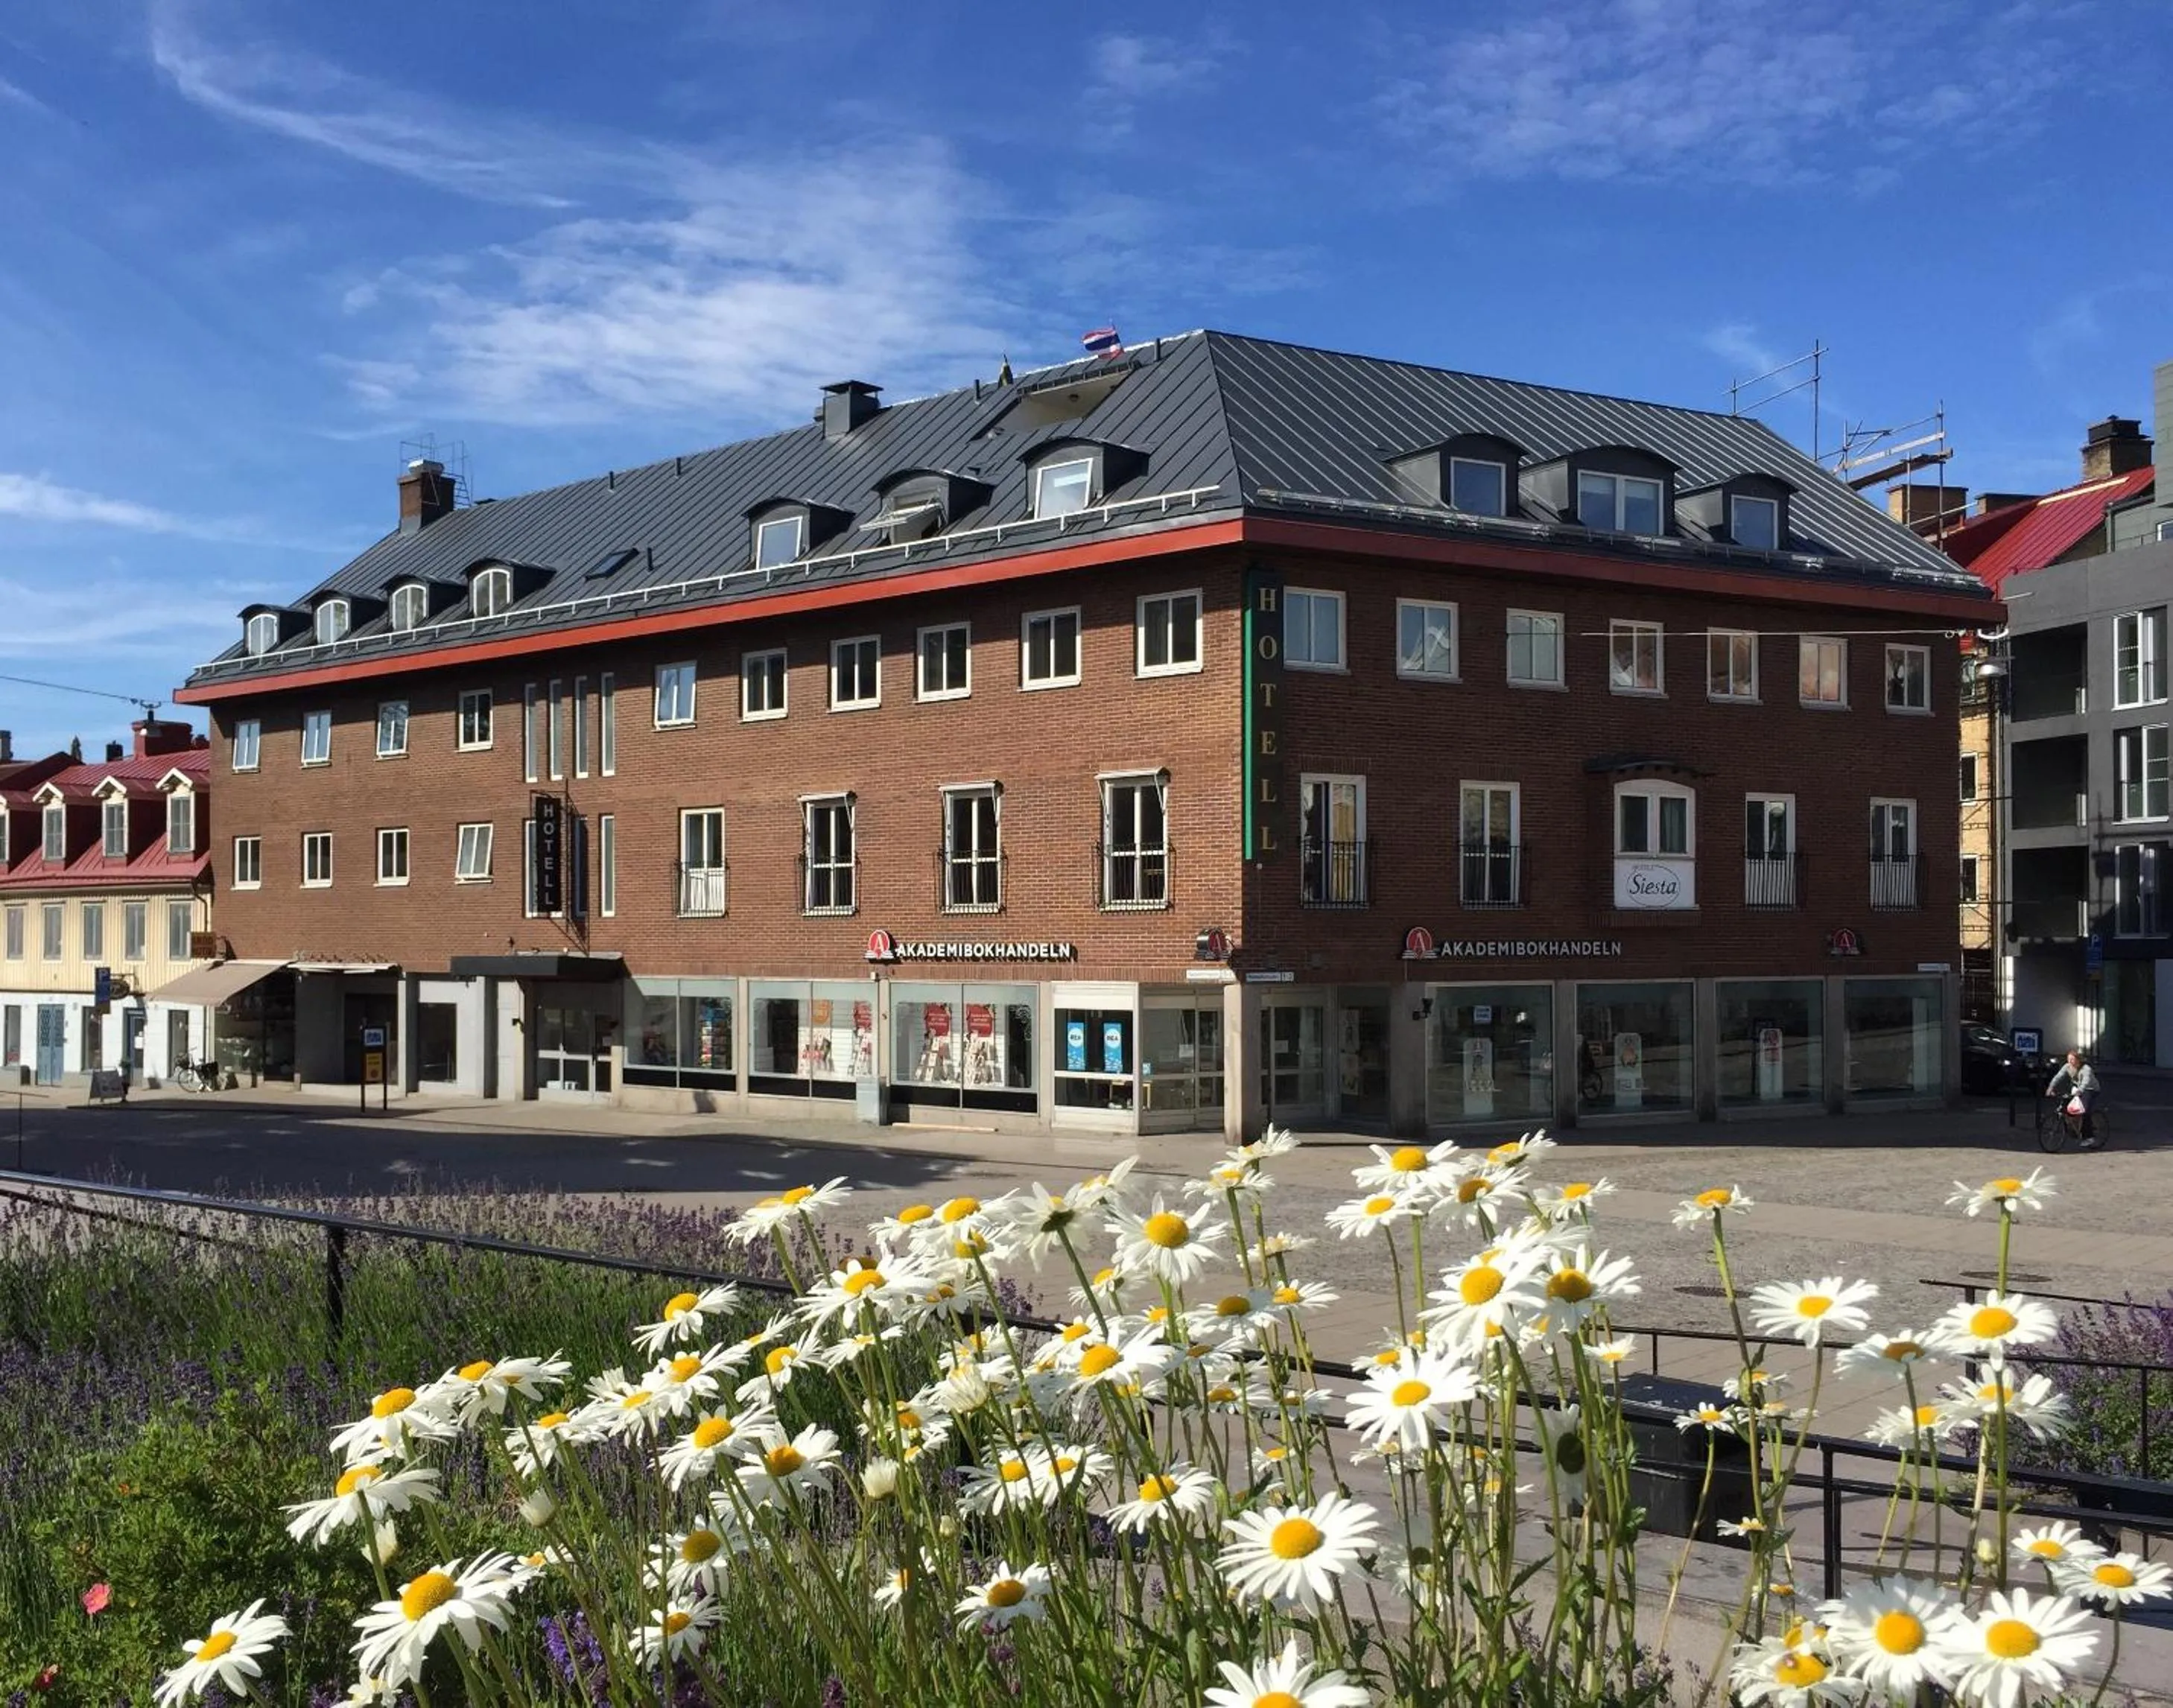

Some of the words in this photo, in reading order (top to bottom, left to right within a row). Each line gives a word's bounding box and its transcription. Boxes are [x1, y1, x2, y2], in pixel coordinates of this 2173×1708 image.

[1258, 587, 1278, 851] HOTELL
[543, 804, 554, 905] HOTELL
[1629, 874, 1677, 895] Siesta
[896, 942, 1070, 958] AKADEMIBOKHANDELN
[1441, 940, 1622, 957] AKADEMIBOKHANDELN
